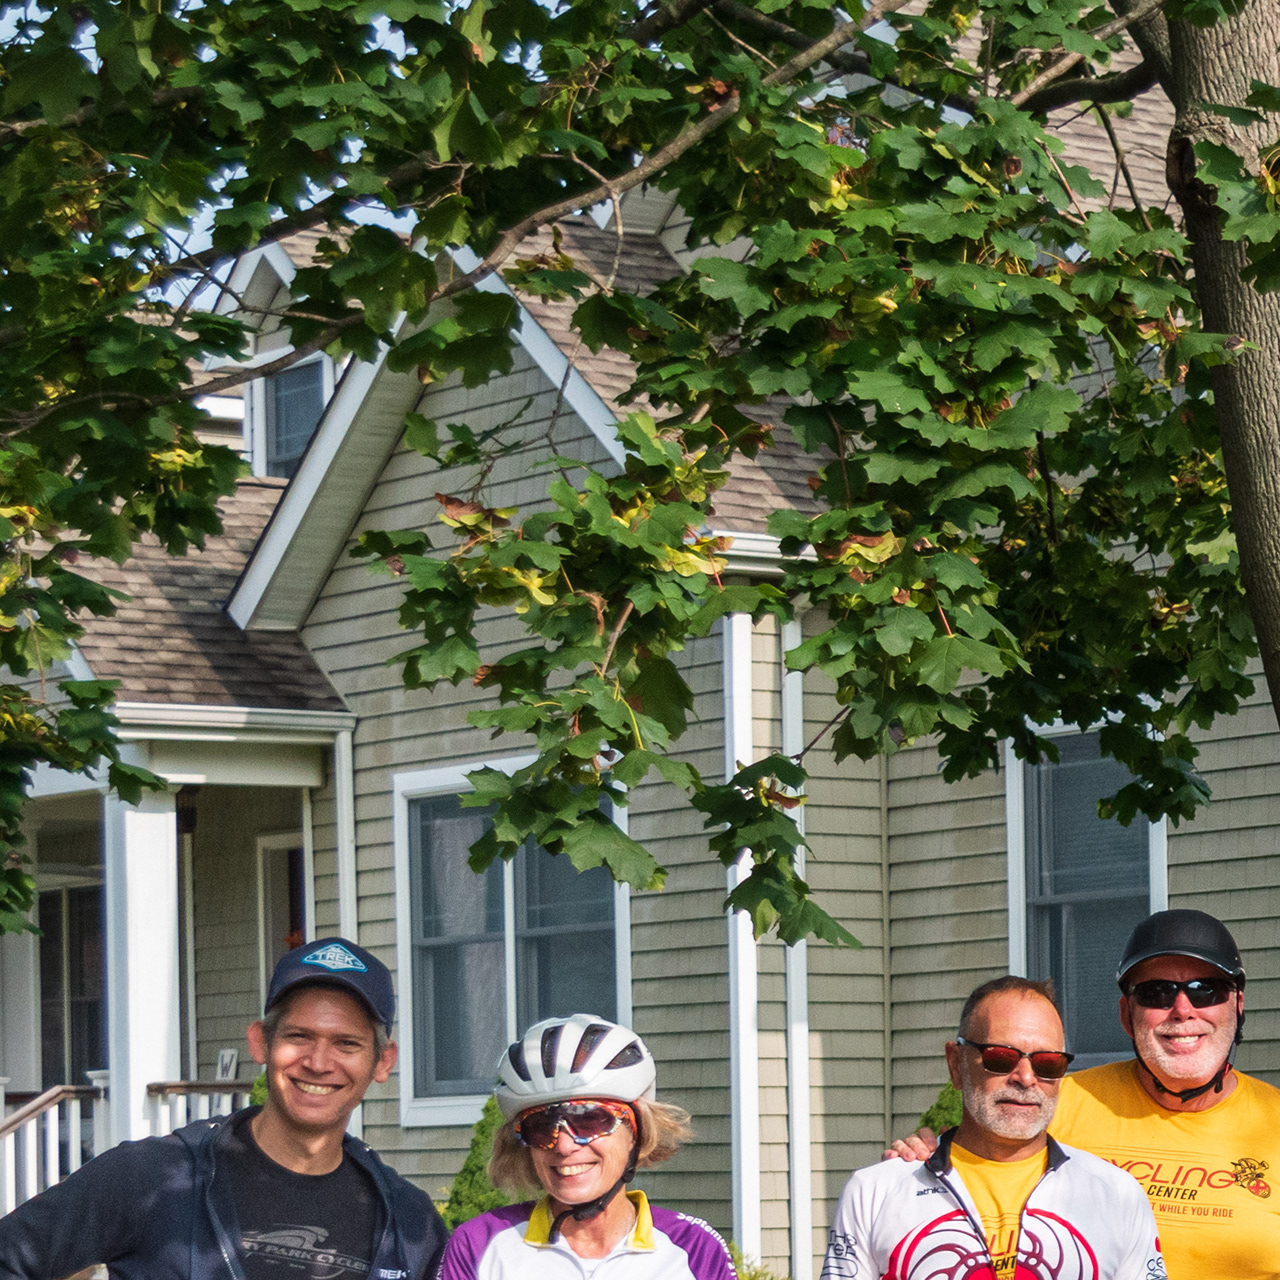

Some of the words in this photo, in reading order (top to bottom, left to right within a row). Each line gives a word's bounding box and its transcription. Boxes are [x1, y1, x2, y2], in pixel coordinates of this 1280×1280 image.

[317, 951, 357, 966] TREK
[1147, 1185, 1198, 1201] CENTER
[1159, 1203, 1188, 1215] WHILE
[1191, 1206, 1209, 1217] YOU
[1212, 1208, 1234, 1218] RIDE
